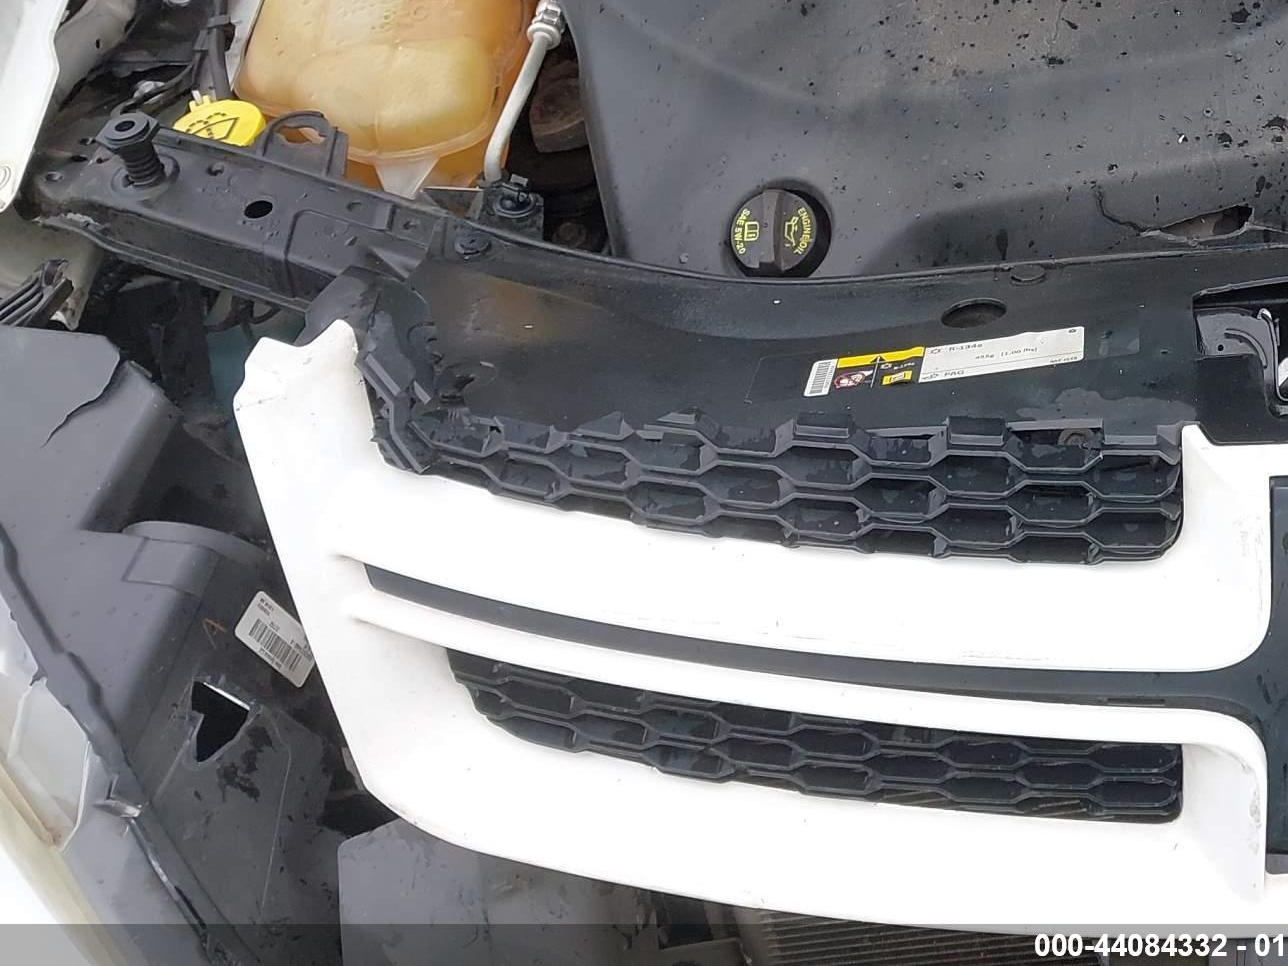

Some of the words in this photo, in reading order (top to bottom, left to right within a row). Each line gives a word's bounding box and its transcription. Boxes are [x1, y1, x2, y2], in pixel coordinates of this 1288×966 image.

[736, 208, 751, 227] SAE
[797, 207, 812, 242] ENGINE
[793, 240, 808, 255] OIL
